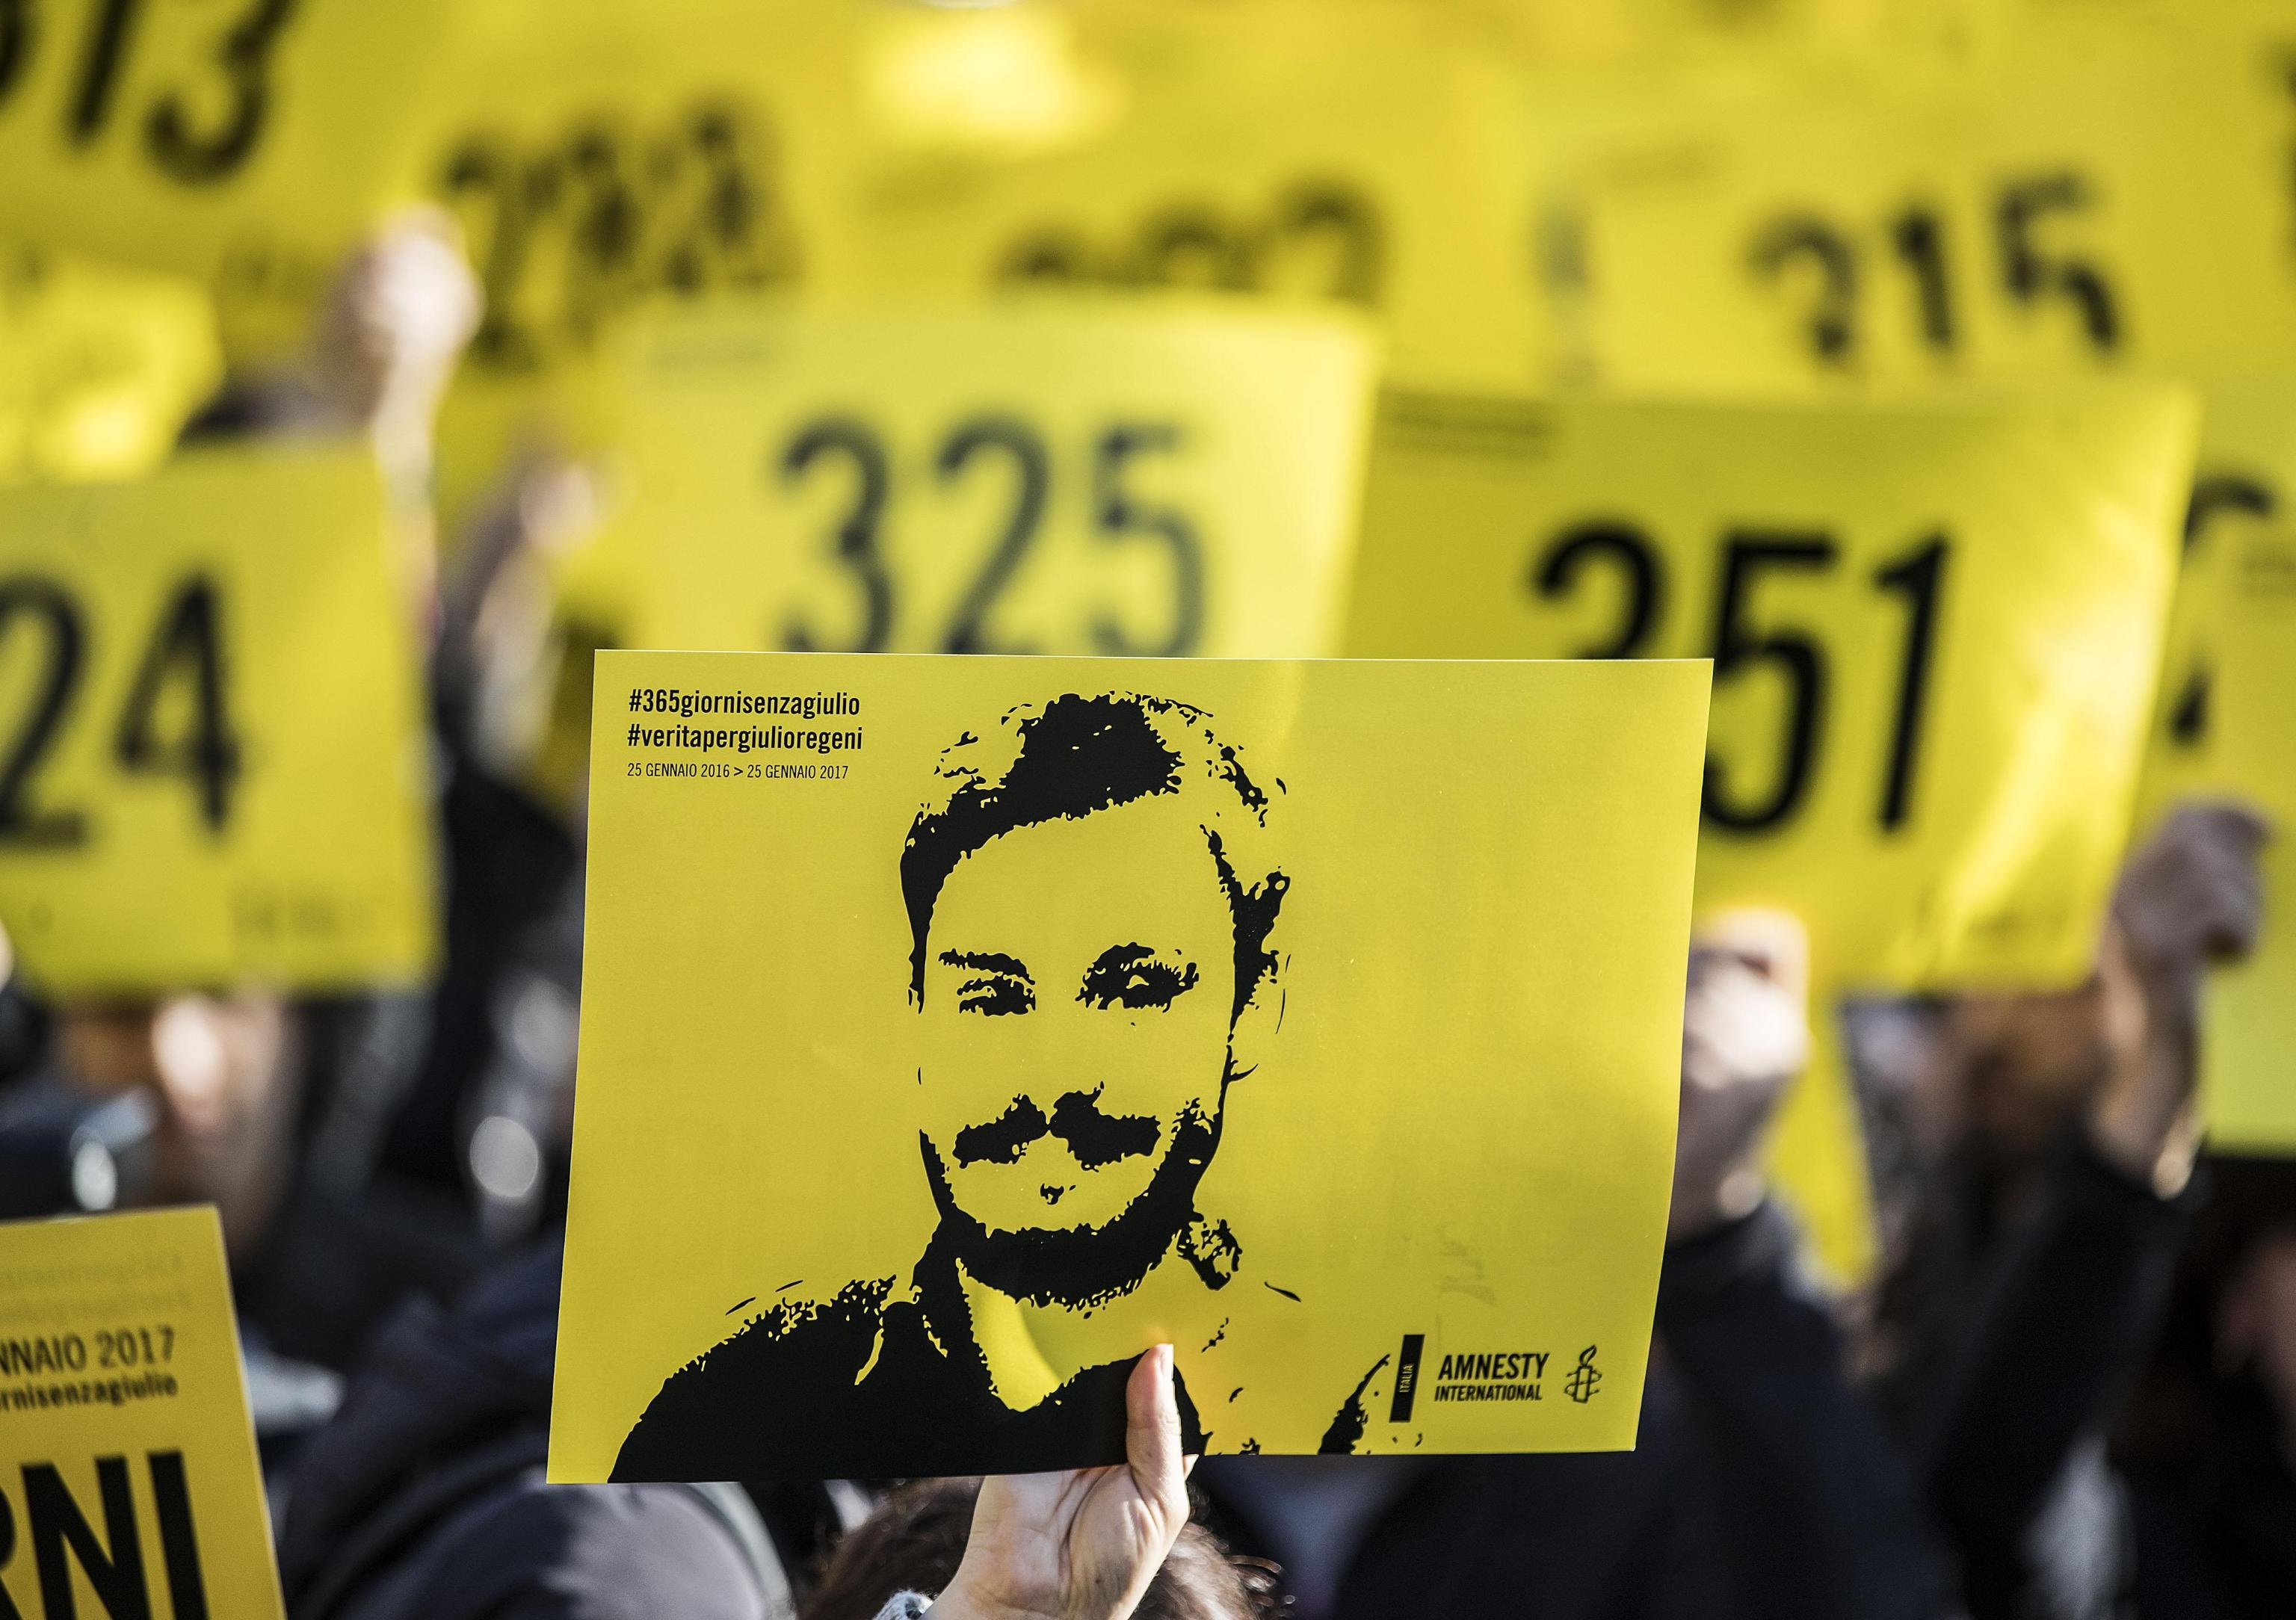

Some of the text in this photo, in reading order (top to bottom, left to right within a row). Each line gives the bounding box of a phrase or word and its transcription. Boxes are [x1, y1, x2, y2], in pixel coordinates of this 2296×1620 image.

[777, 417, 1205, 658] 325
[629, 689, 860, 720] #365giornisenzagiulio
[627, 723, 862, 754] #veritapergiulioregeni
[627, 763, 642, 777] 25
[645, 763, 697, 778] GENNAIO
[701, 764, 730, 778] 2016
[747, 764, 762, 779] 25
[765, 764, 816, 779] GENNAIO
[819, 765, 849, 779] 2017
[95, 1324, 176, 1369] 2017
[1398, 1363, 1414, 1392] ITALIA
[1437, 1352, 1550, 1381] AMNESTY
[1434, 1384, 1543, 1402] INTERNATIONAL
